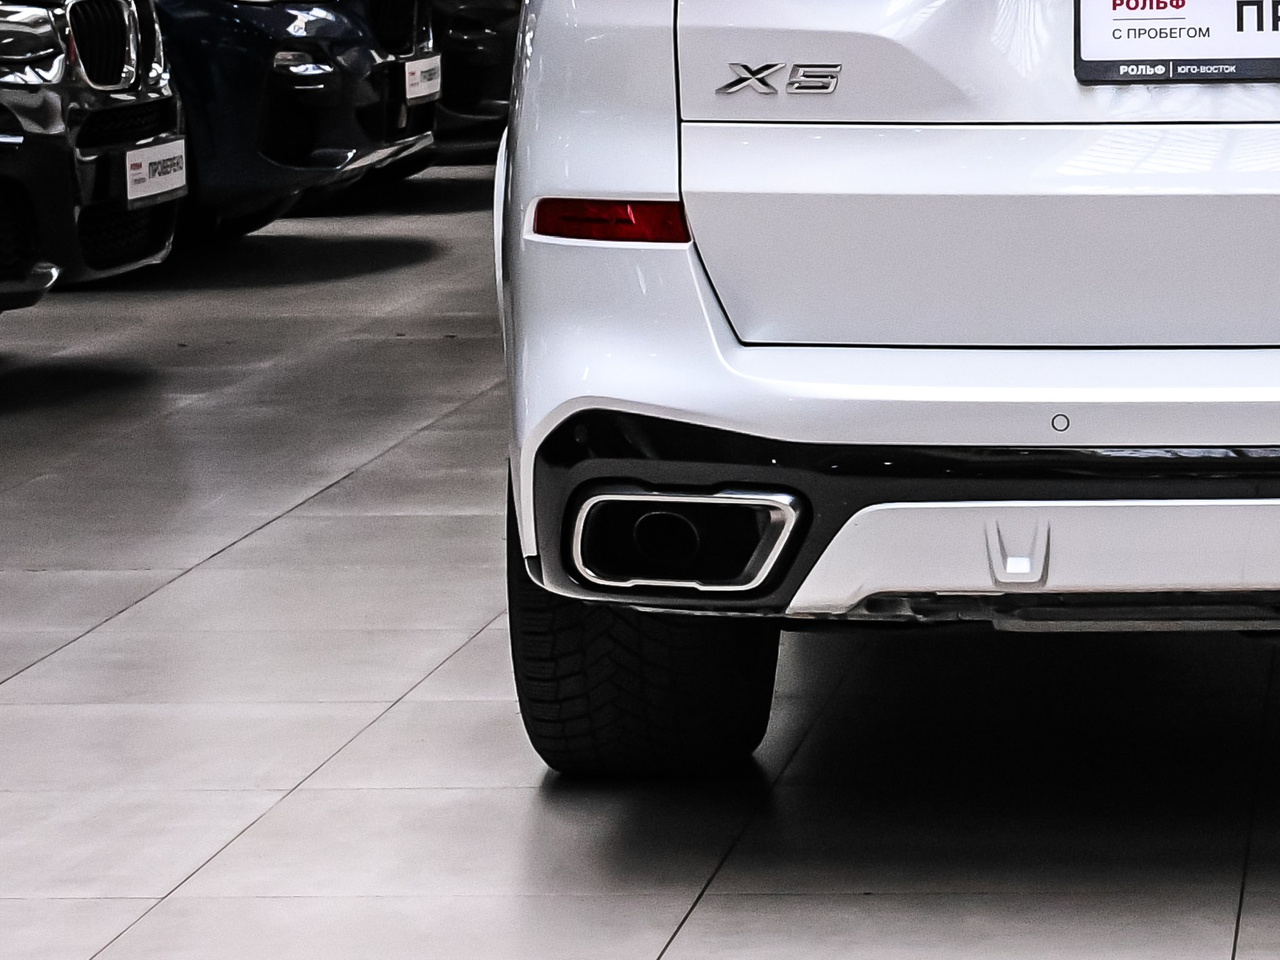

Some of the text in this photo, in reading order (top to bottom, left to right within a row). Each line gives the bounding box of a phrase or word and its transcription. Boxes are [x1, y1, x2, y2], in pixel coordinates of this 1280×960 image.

[1111, 27, 1211, 40] С ПРОБЕГОМ
[1119, 65, 1166, 75] РОЛЬФ
[1177, 65, 1236, 74] ЮГО-ВОСТОК
[715, 63, 842, 94] X5
